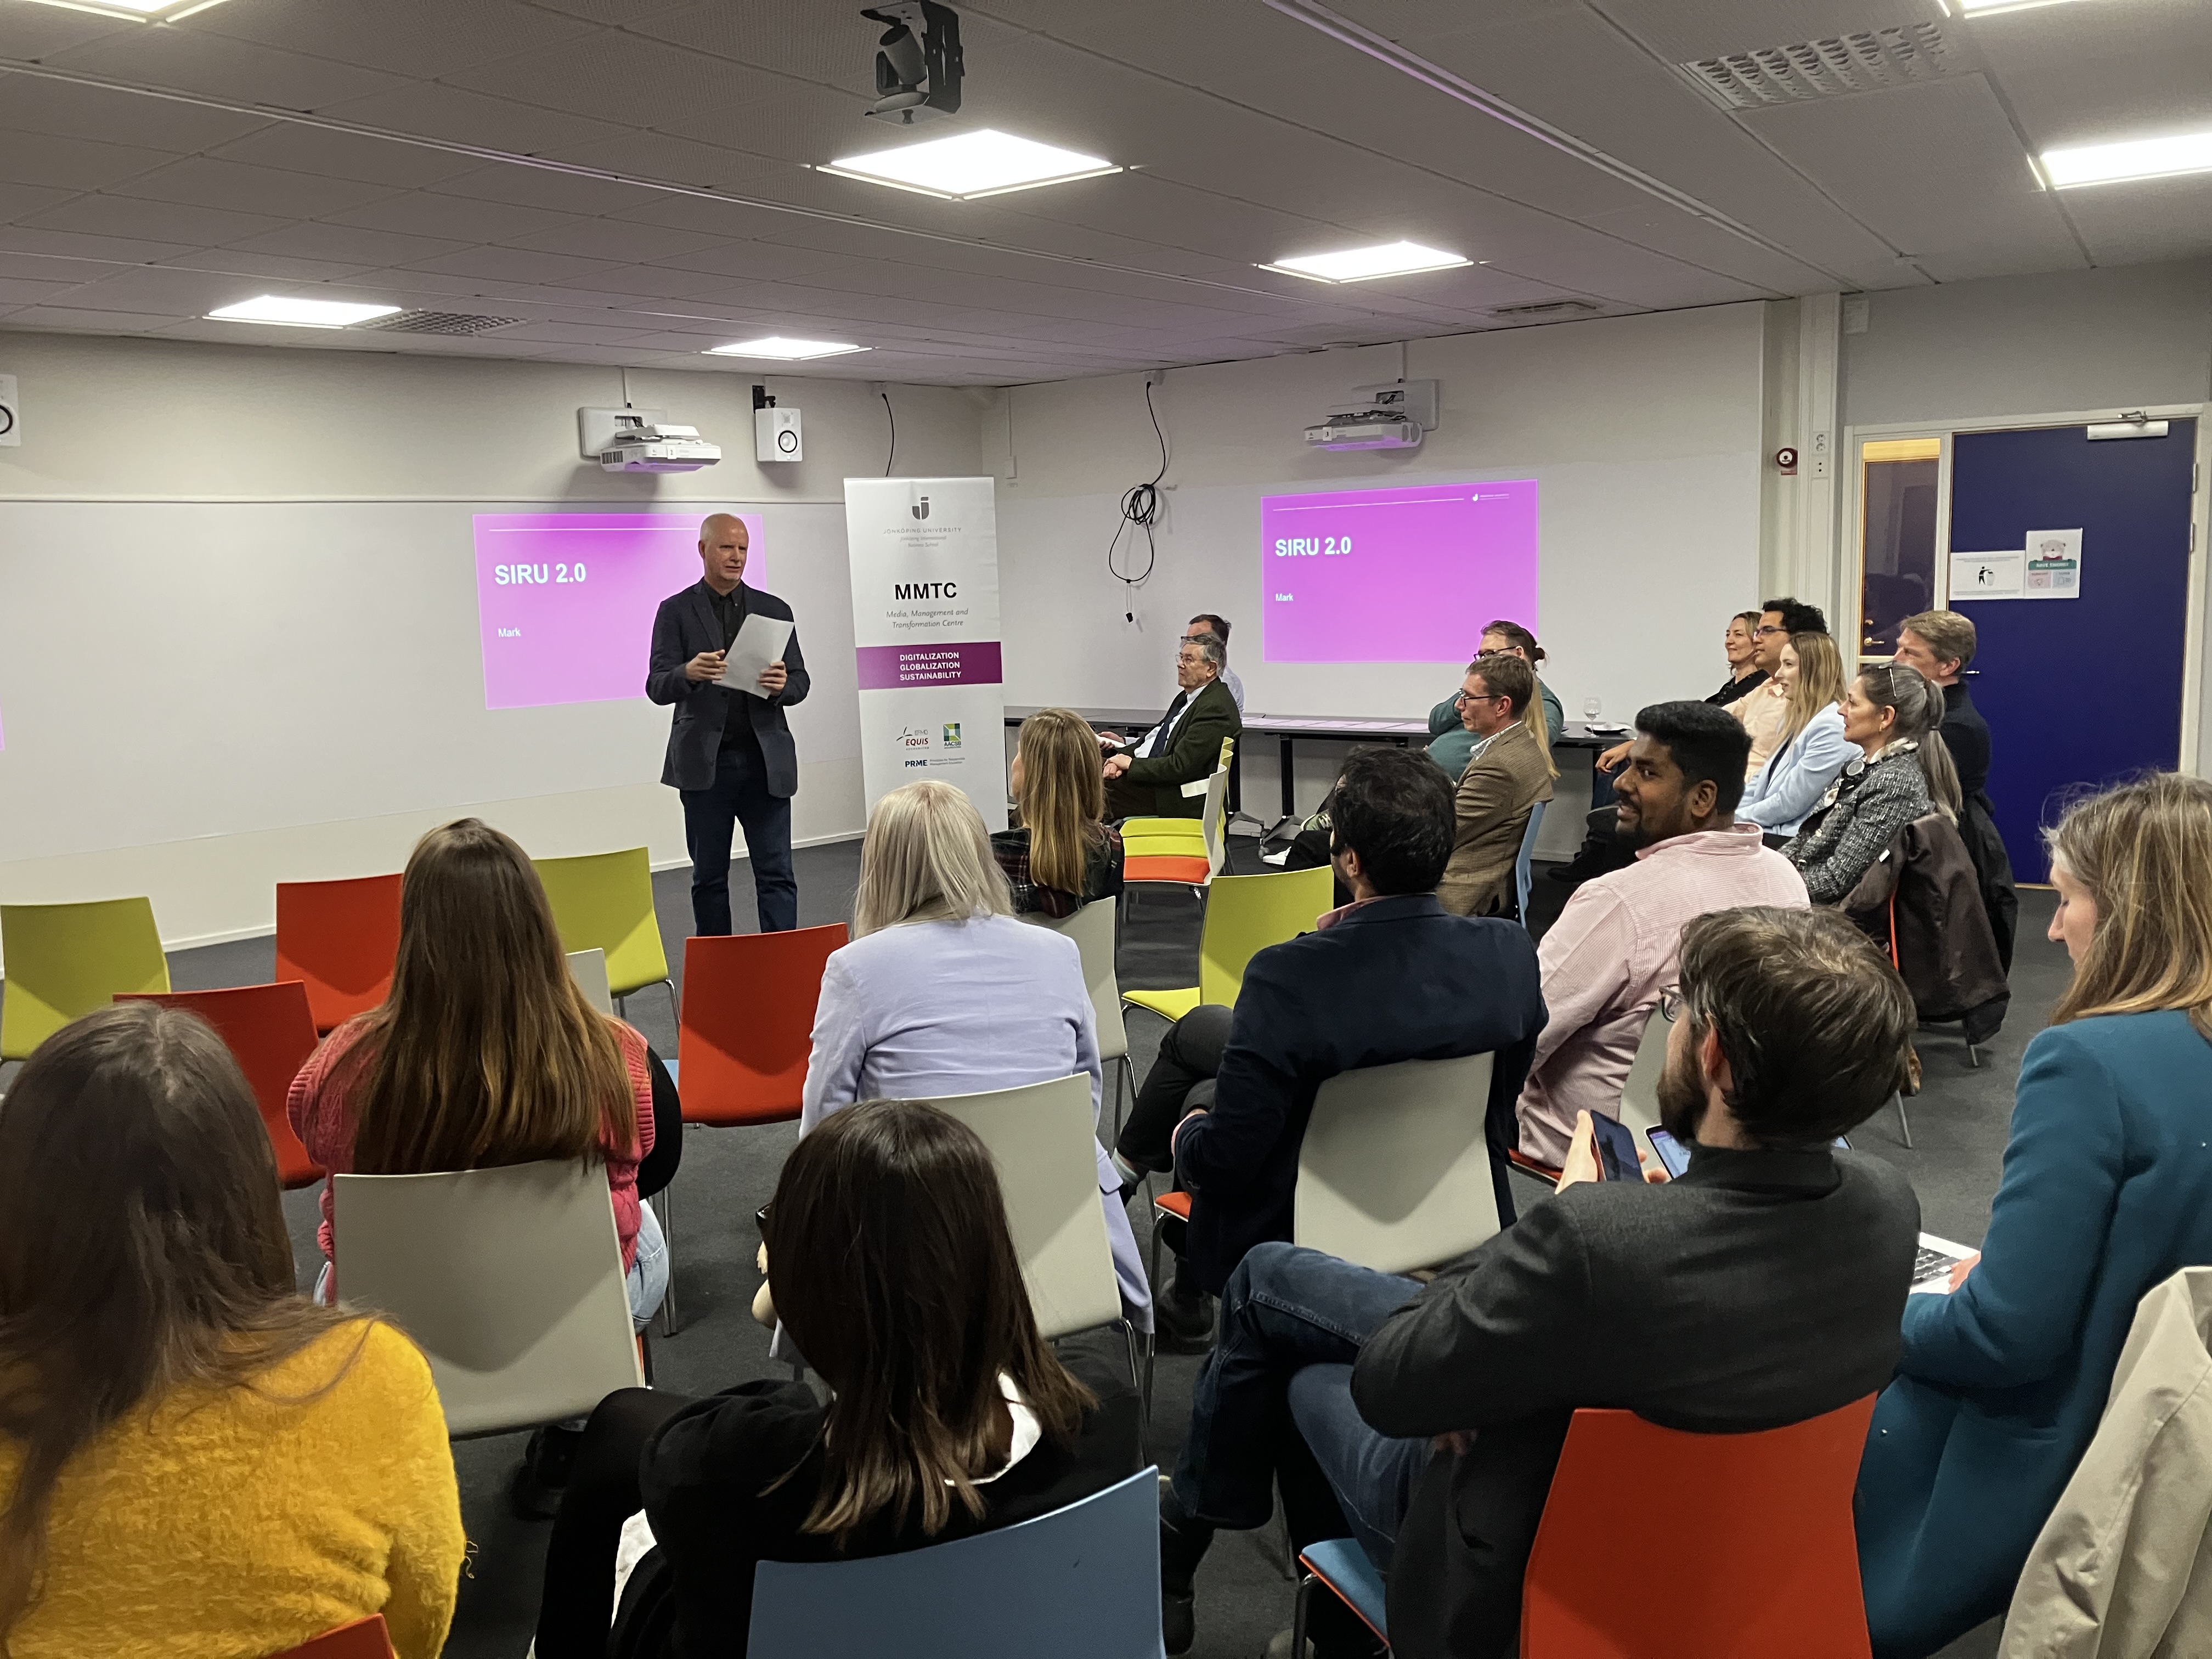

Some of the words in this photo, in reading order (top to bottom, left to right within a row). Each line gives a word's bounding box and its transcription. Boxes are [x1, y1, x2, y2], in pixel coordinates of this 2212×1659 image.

[1276, 538, 1319, 557] SIRU
[1324, 537, 1352, 555] 2.0
[494, 563, 549, 585] SIRU
[555, 562, 586, 583] 2.0
[894, 582, 957, 600] MMTC
[1275, 593, 1294, 602] Mark
[886, 610, 909, 618] Media,
[911, 610, 953, 618] Management
[892, 620, 940, 630] Transformation
[498, 627, 521, 637] Mark
[899, 652, 960, 662] DIGITALIZATION
[900, 662, 960, 672] GLOBALIZATION
[900, 671, 962, 681] SUSTAINABILITY
[906, 738, 929, 746] EQUIS
[905, 759, 928, 768] PRME
